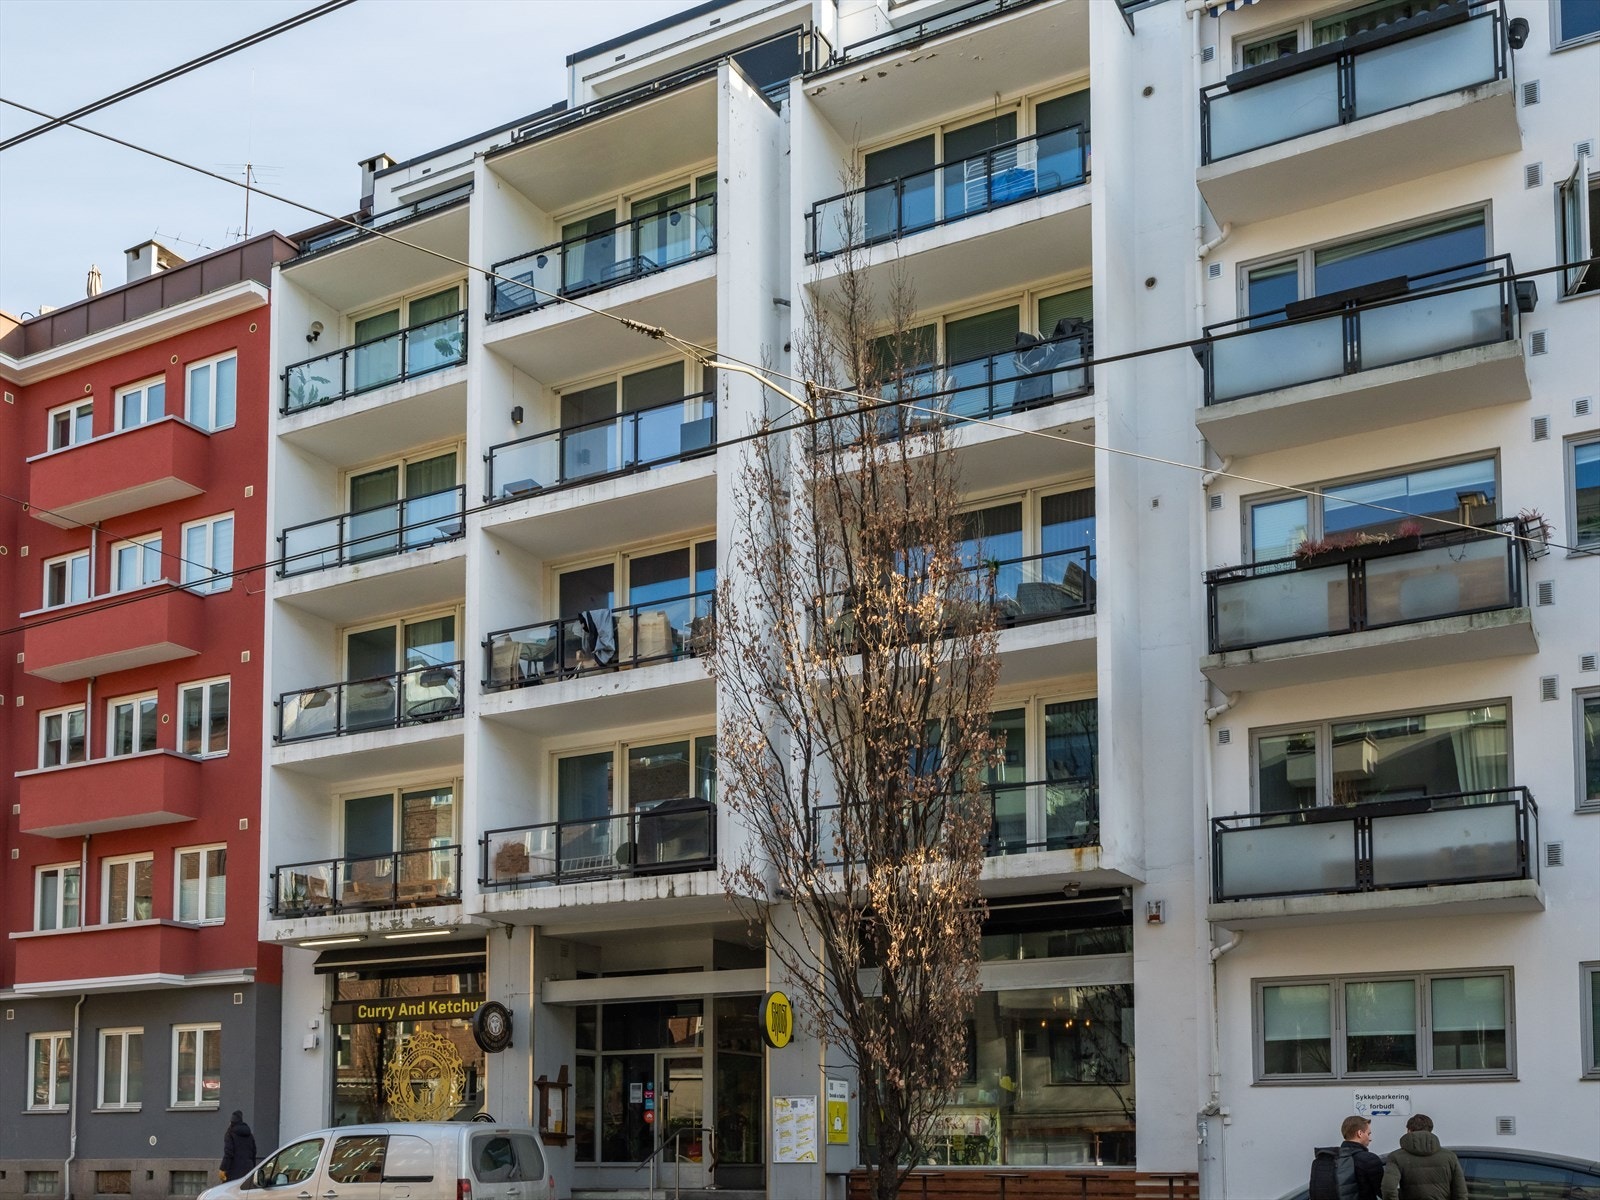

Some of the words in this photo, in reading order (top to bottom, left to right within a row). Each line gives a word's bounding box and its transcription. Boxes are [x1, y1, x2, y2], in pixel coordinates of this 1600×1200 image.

[358, 1004, 395, 1020] Curry
[398, 1001, 425, 1016] And
[1355, 1093, 1409, 1101] Sykkelparkering
